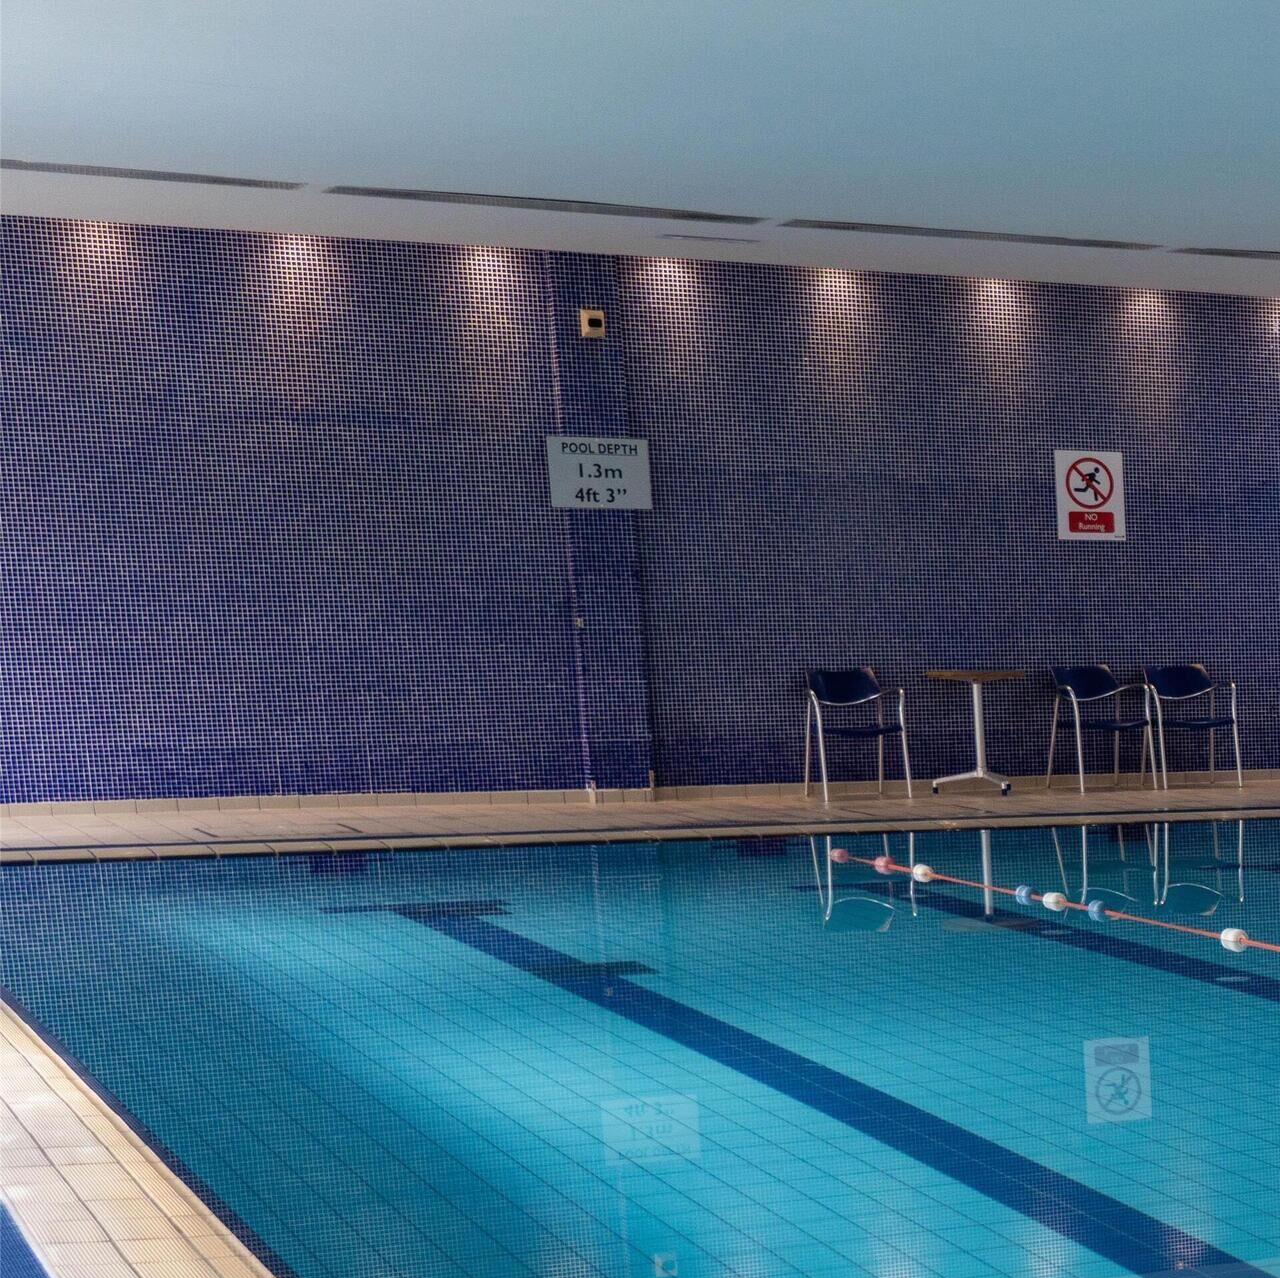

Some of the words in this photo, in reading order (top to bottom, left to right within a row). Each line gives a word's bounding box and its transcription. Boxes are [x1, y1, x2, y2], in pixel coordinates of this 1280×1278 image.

[561, 442, 595, 454] POOL
[598, 443, 638, 455] DEPTH
[578, 463, 623, 479] 1.3m
[575, 488, 600, 503] 4ft
[1084, 513, 1098, 521] NO
[1078, 523, 1106, 533] Running
